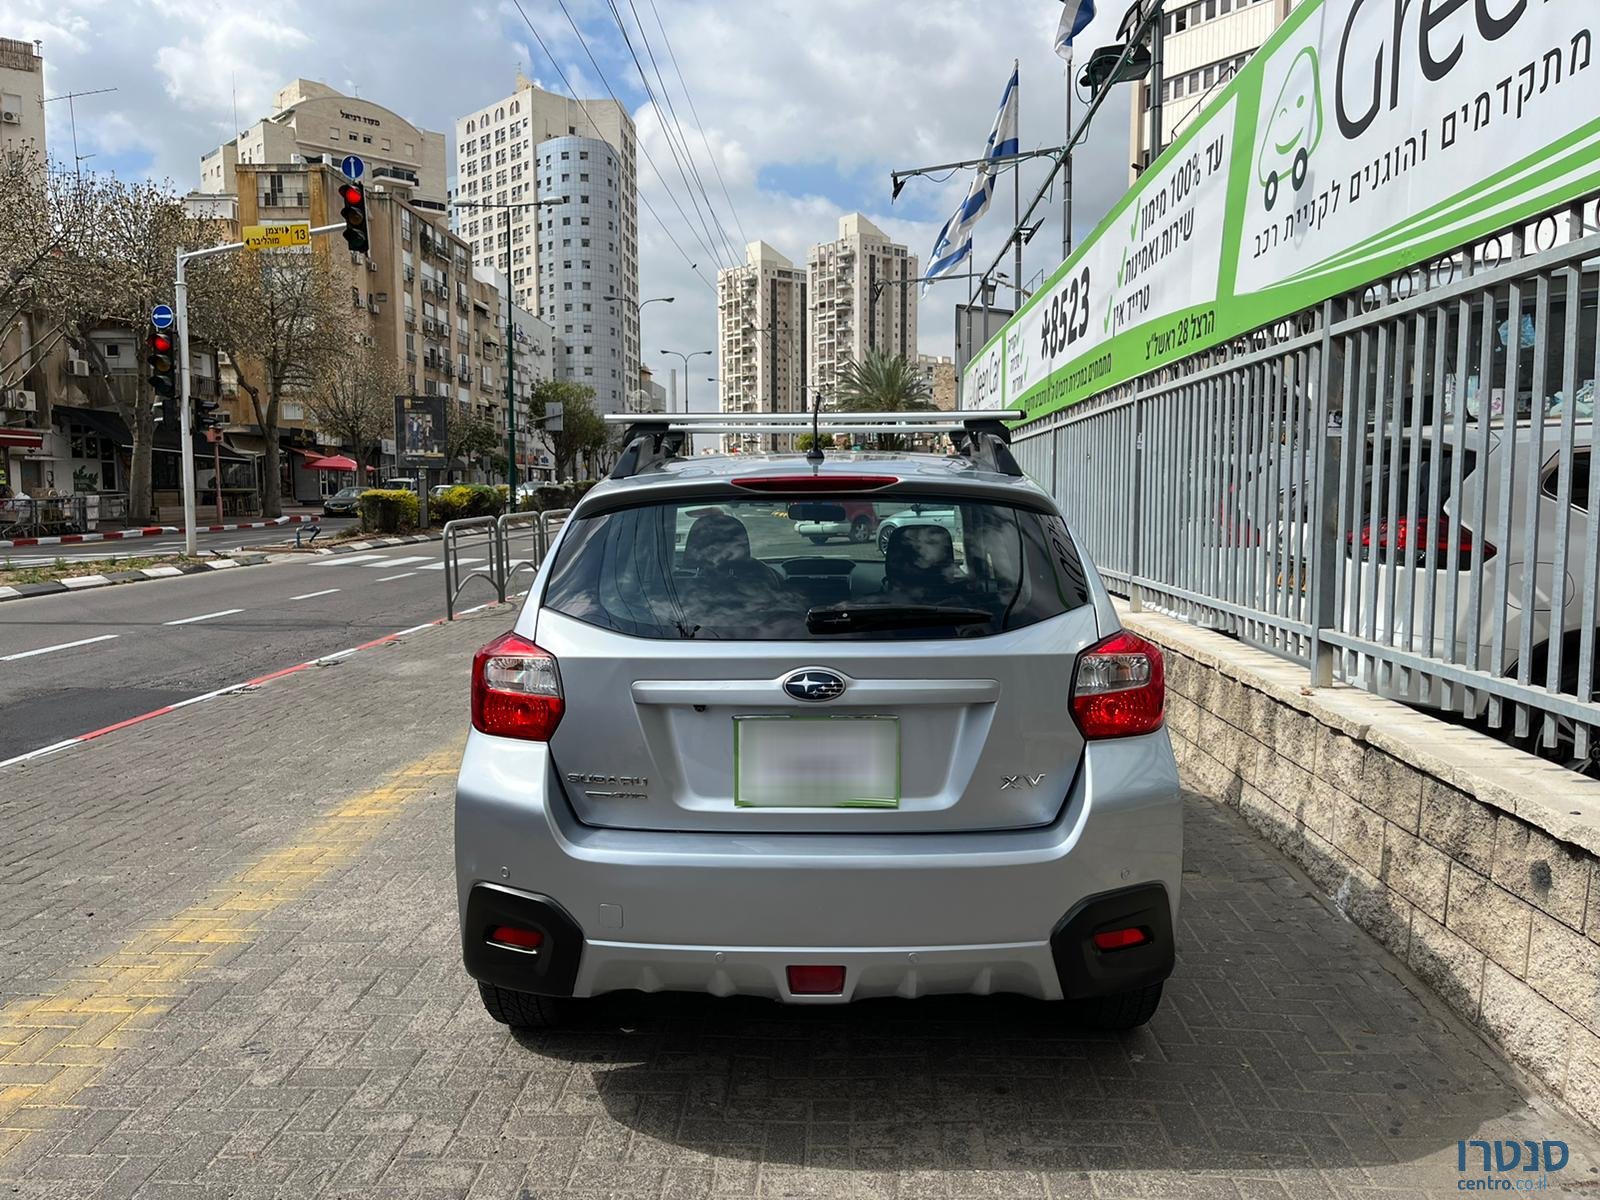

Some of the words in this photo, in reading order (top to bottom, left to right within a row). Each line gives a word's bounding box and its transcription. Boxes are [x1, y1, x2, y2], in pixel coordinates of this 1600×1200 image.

[1335, 0, 1553, 140] Gre
[1441, 28, 1592, 150] מתקדמים
[1206, 133, 1224, 176] עד
[1350, 128, 1428, 203] והוגנים
[1170, 152, 1201, 208] 100%
[1141, 188, 1167, 242] מימון
[1283, 179, 1341, 241] לקניית
[251, 235, 280, 245] מוהליבר
[265, 226, 285, 237] ויצמן
[294, 229, 306, 241] 13
[1160, 207, 1195, 260] שירות
[1253, 223, 1278, 259] רכב
[1124, 236, 1159, 286] ואמינות
[1112, 301, 1126, 338] אין
[1127, 284, 1150, 321] טרייד
[1177, 317, 1189, 347] 28
[1190, 310, 1215, 341] הרצל
[567, 772, 648, 787] SUBARU
[1000, 773, 1046, 790] XV
